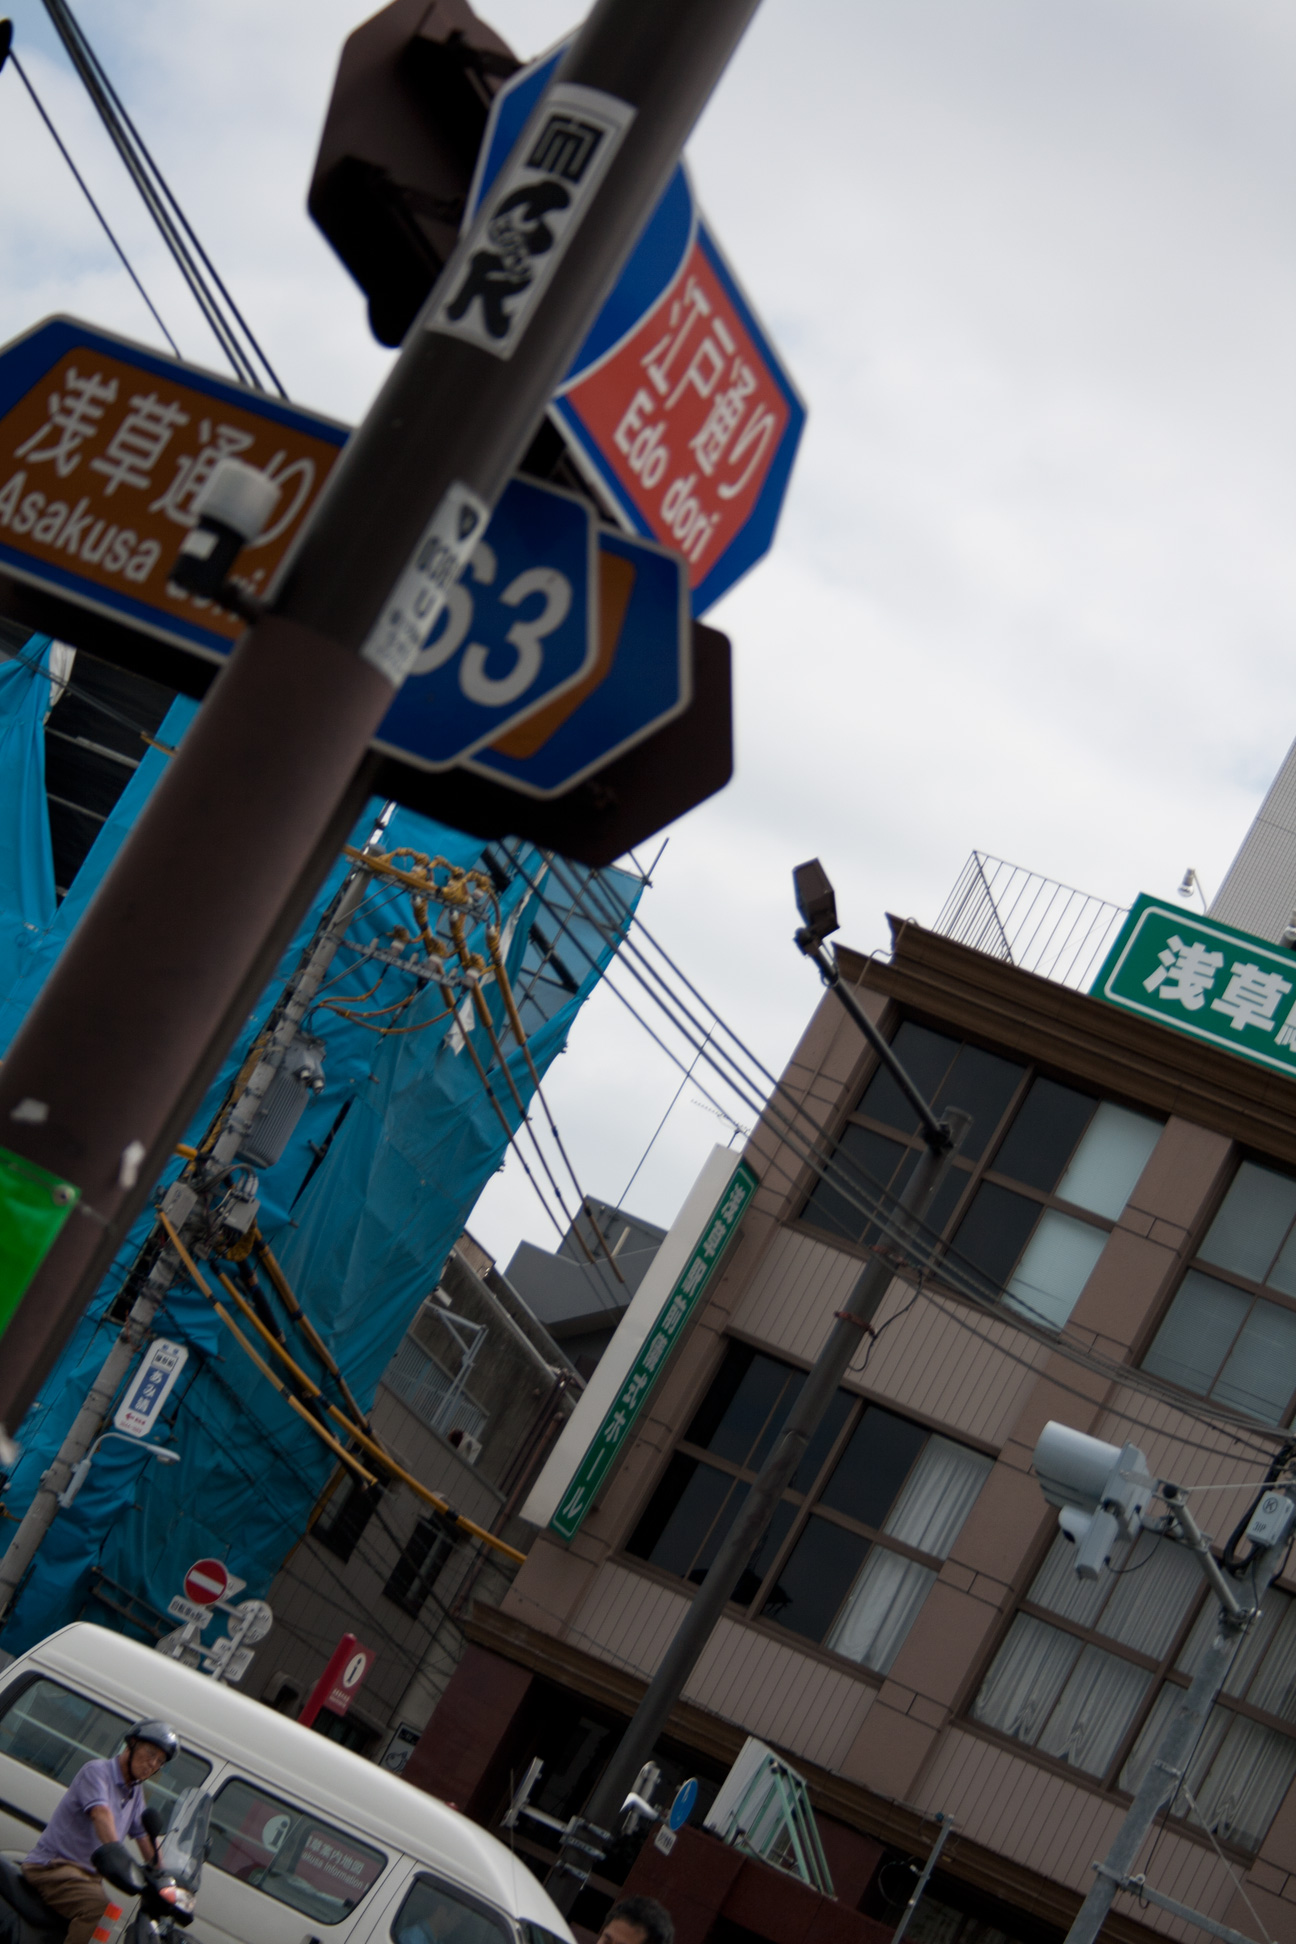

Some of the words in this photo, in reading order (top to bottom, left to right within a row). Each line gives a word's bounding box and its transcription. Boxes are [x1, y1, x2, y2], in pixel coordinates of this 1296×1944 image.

[612, 387, 671, 491] Edo
[659, 473, 725, 565] dori
[640, 274, 777, 500] 江戸通り
[0, 470, 163, 585] Asakusa
